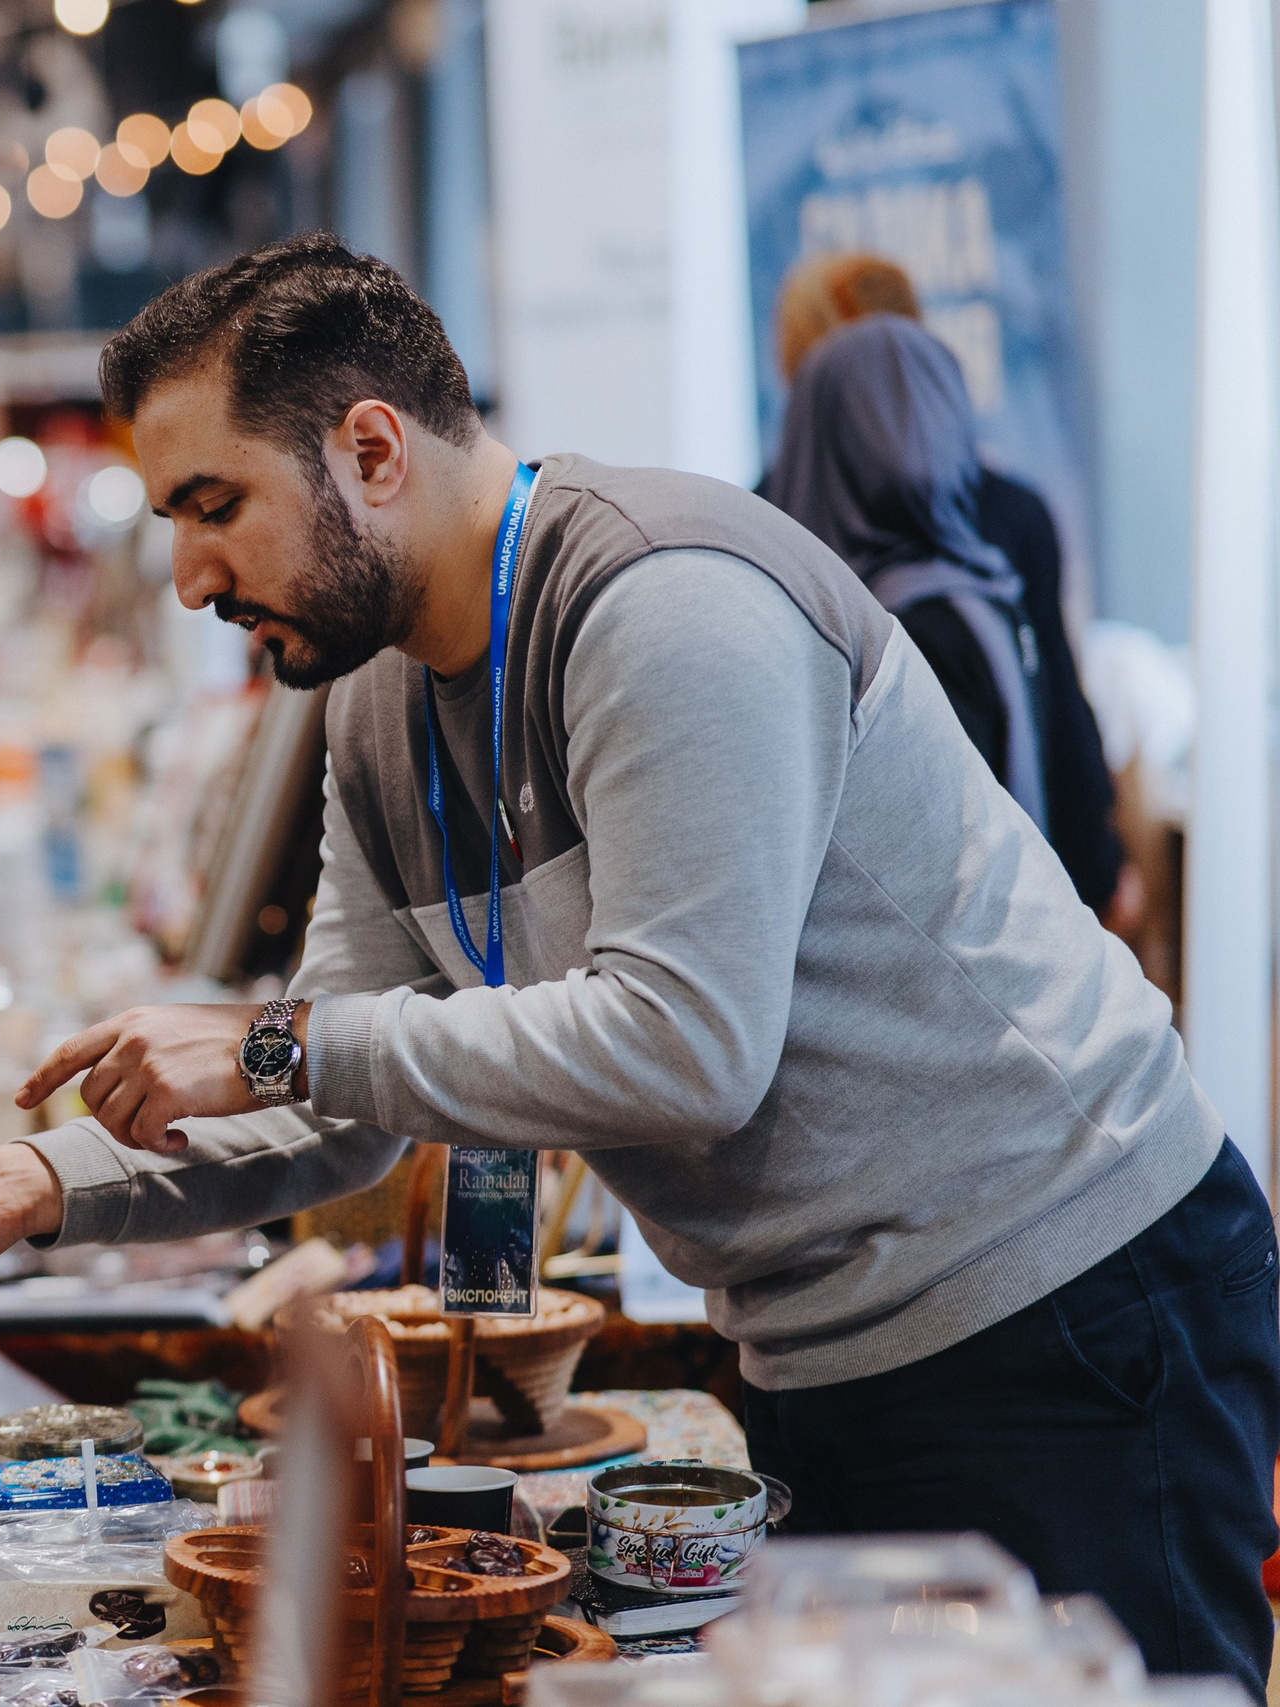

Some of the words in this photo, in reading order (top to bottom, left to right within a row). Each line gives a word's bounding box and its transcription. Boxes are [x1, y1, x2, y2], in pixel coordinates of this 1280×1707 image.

[497, 497, 526, 596] UMMAFORUM.RU
[494, 667, 502, 774] MAFORUM.RU
[460, 1150, 506, 1164] FORUM
[459, 1166, 530, 1189] Ramadan
[446, 1288, 528, 1304] ЭКСПОНЕНТ
[683, 1542, 720, 1564] Gift
